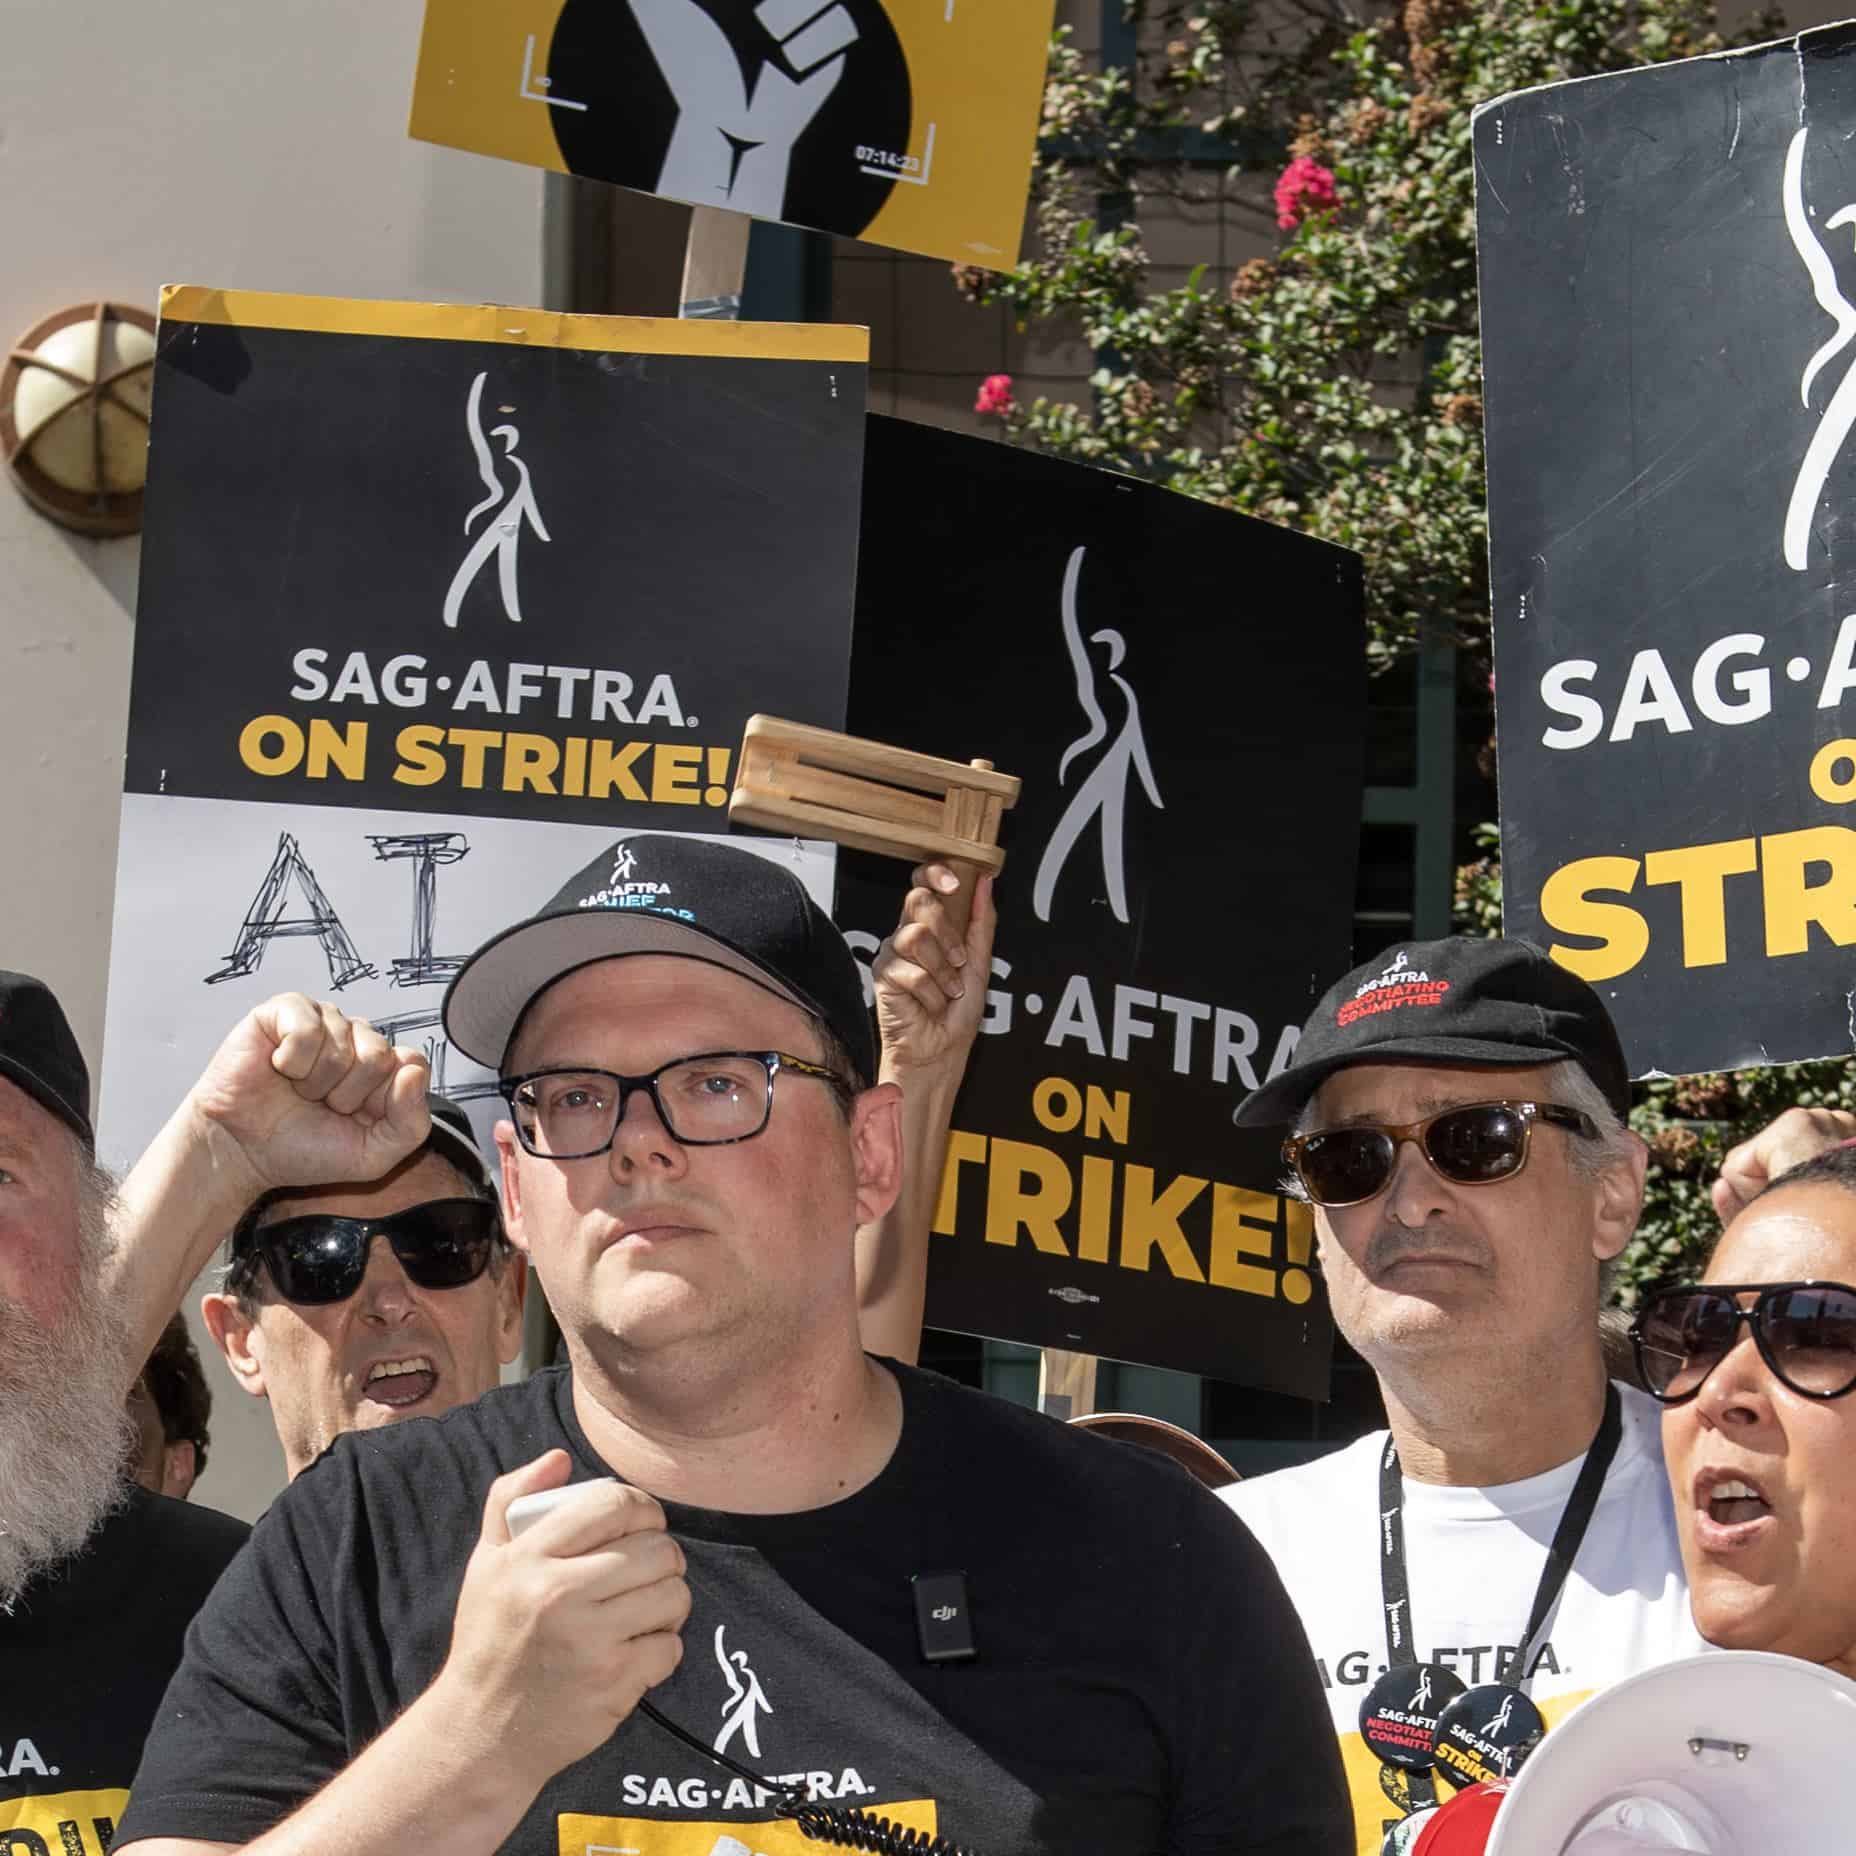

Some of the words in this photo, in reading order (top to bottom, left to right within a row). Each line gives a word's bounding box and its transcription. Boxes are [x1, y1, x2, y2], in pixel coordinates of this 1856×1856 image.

[239, 714, 369, 781] ON
[393, 727, 732, 807] STRIKE!
[204, 830, 470, 990] AI
[1033, 1076, 1131, 1146] ON
[930, 1126, 1312, 1305] TRIKE!
[1366, 1718, 1431, 1741] NEGOTIAT
